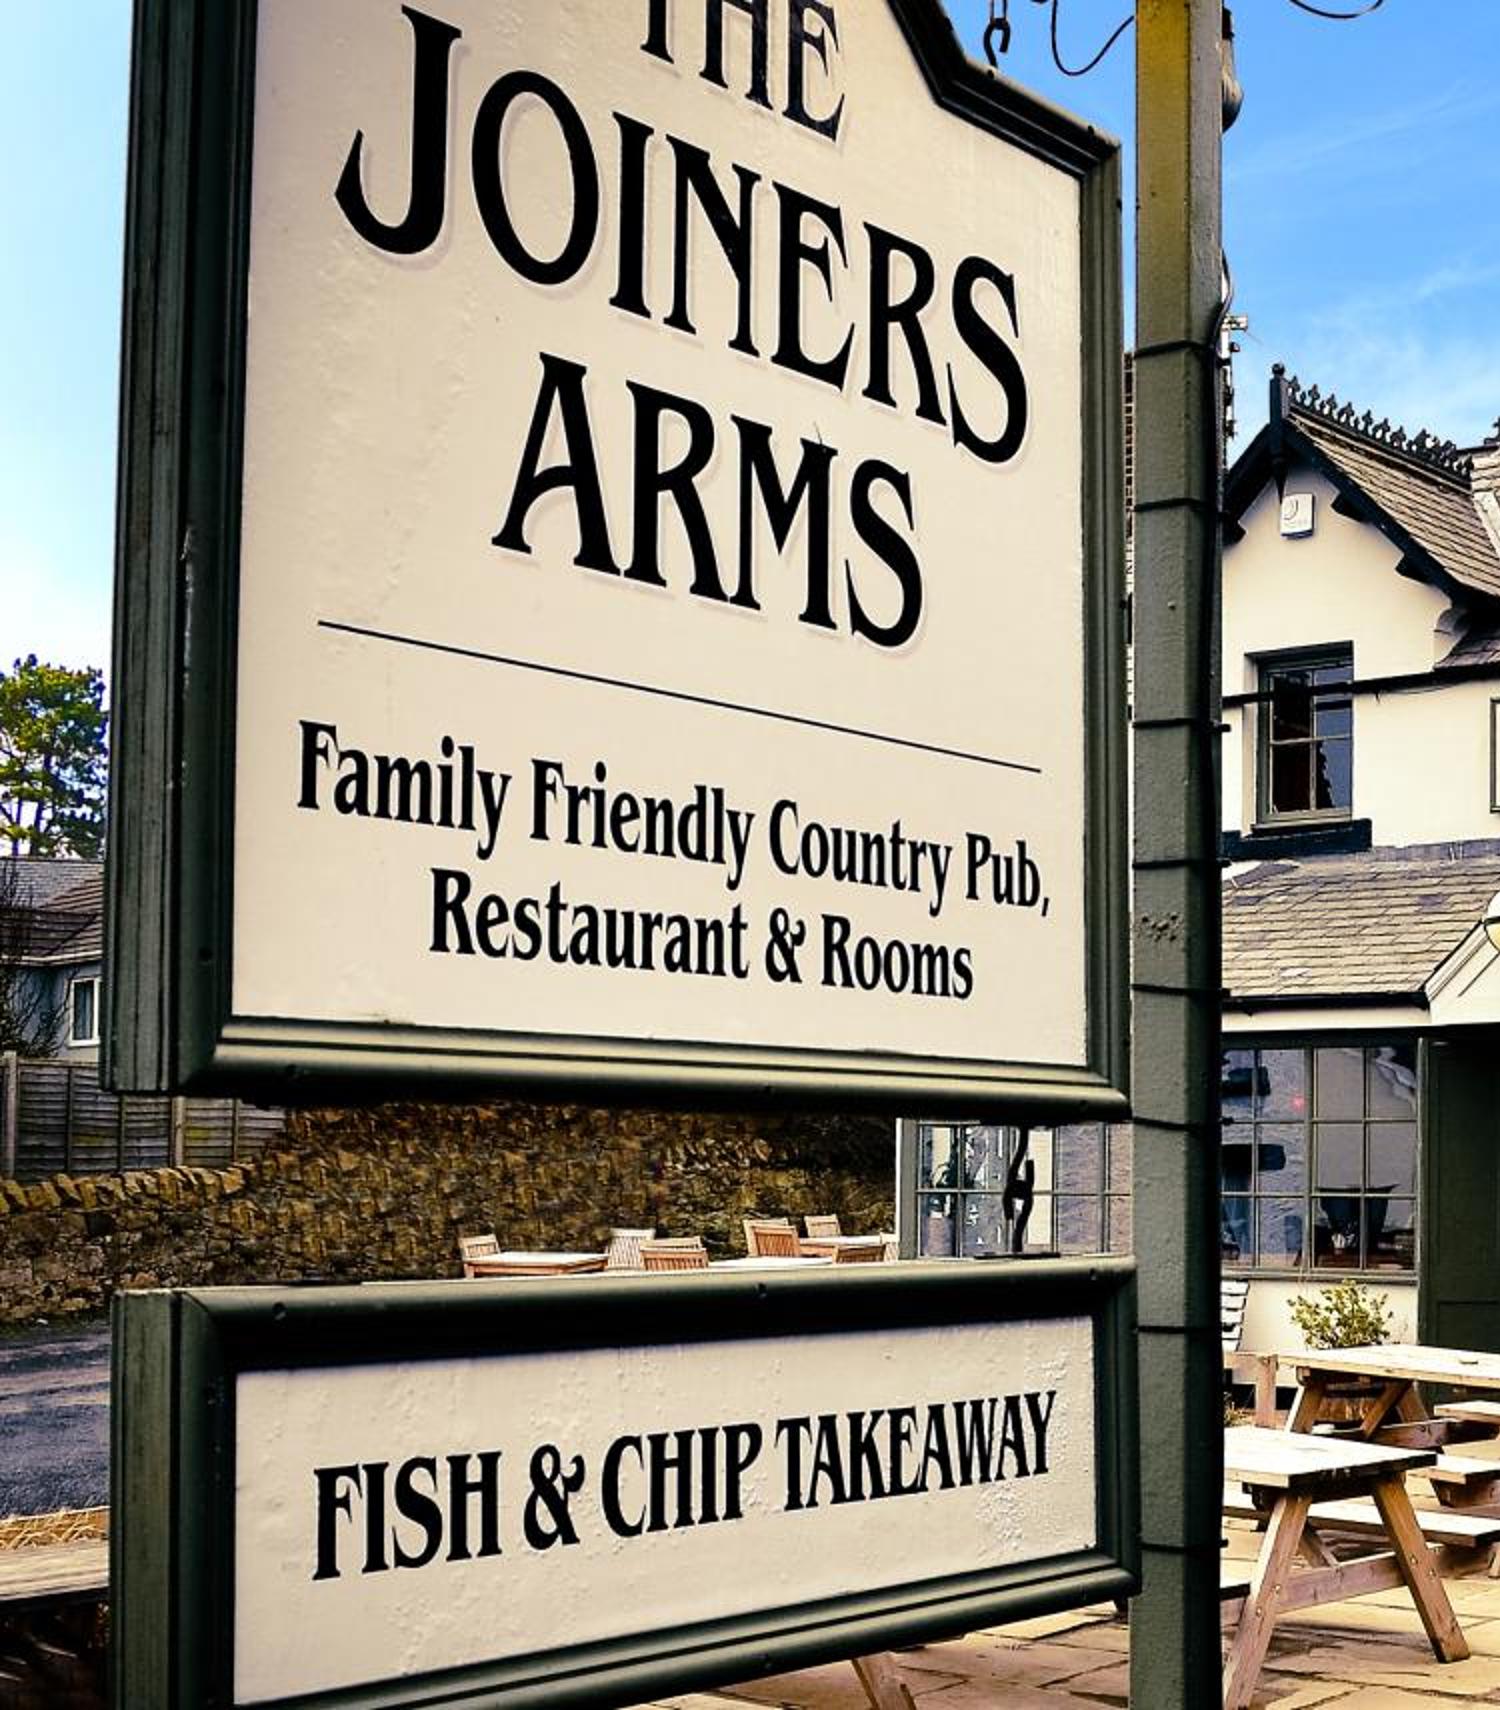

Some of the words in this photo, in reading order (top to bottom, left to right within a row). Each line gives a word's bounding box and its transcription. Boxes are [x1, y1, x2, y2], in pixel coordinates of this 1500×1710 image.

[334, 4, 1028, 464] JOINERS
[491, 351, 923, 648] ARMS
[297, 719, 513, 861] Family
[529, 758, 756, 891] Friendly
[769, 799, 953, 918] Country
[965, 832, 1050, 917] Pub,
[429, 867, 750, 979] Restaurant
[765, 907, 807, 984] &
[821, 913, 974, 1000] Rooms
[311, 1450, 503, 1581] FISH
[523, 1443, 586, 1551] &
[601, 1422, 763, 1538] CHIP
[774, 1389, 1057, 1512] TAKEAWAY
